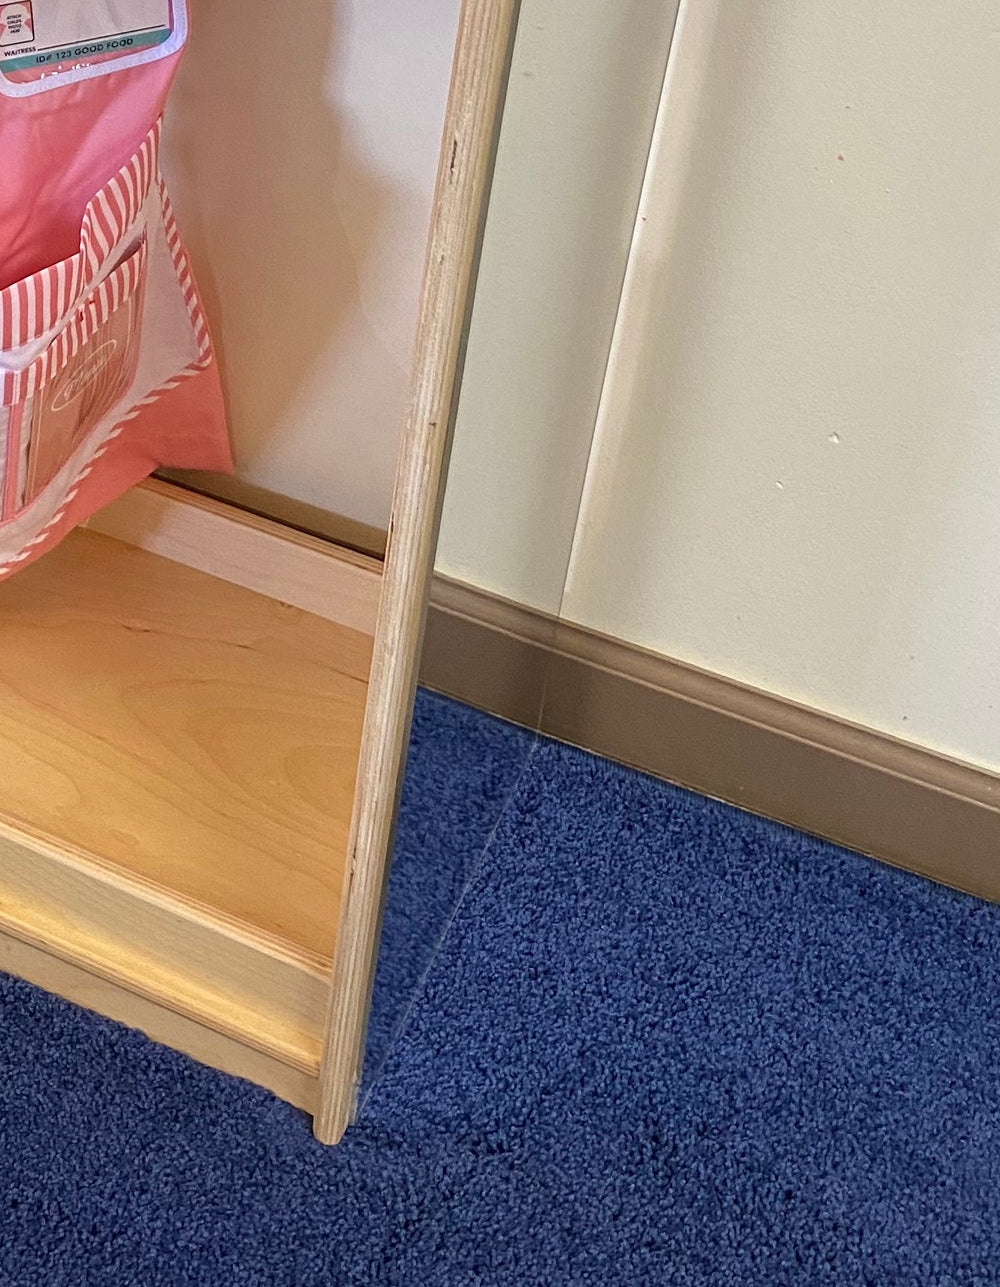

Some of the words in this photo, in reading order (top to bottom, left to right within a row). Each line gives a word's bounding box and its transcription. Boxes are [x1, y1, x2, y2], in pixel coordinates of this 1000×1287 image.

[4, 46, 36, 57] WAITRESS
[36, 53, 53, 64] ID#
[56, 50, 73, 60] 123
[74, 44, 104, 56] GOOD
[106, 38, 134, 50] FOOD
